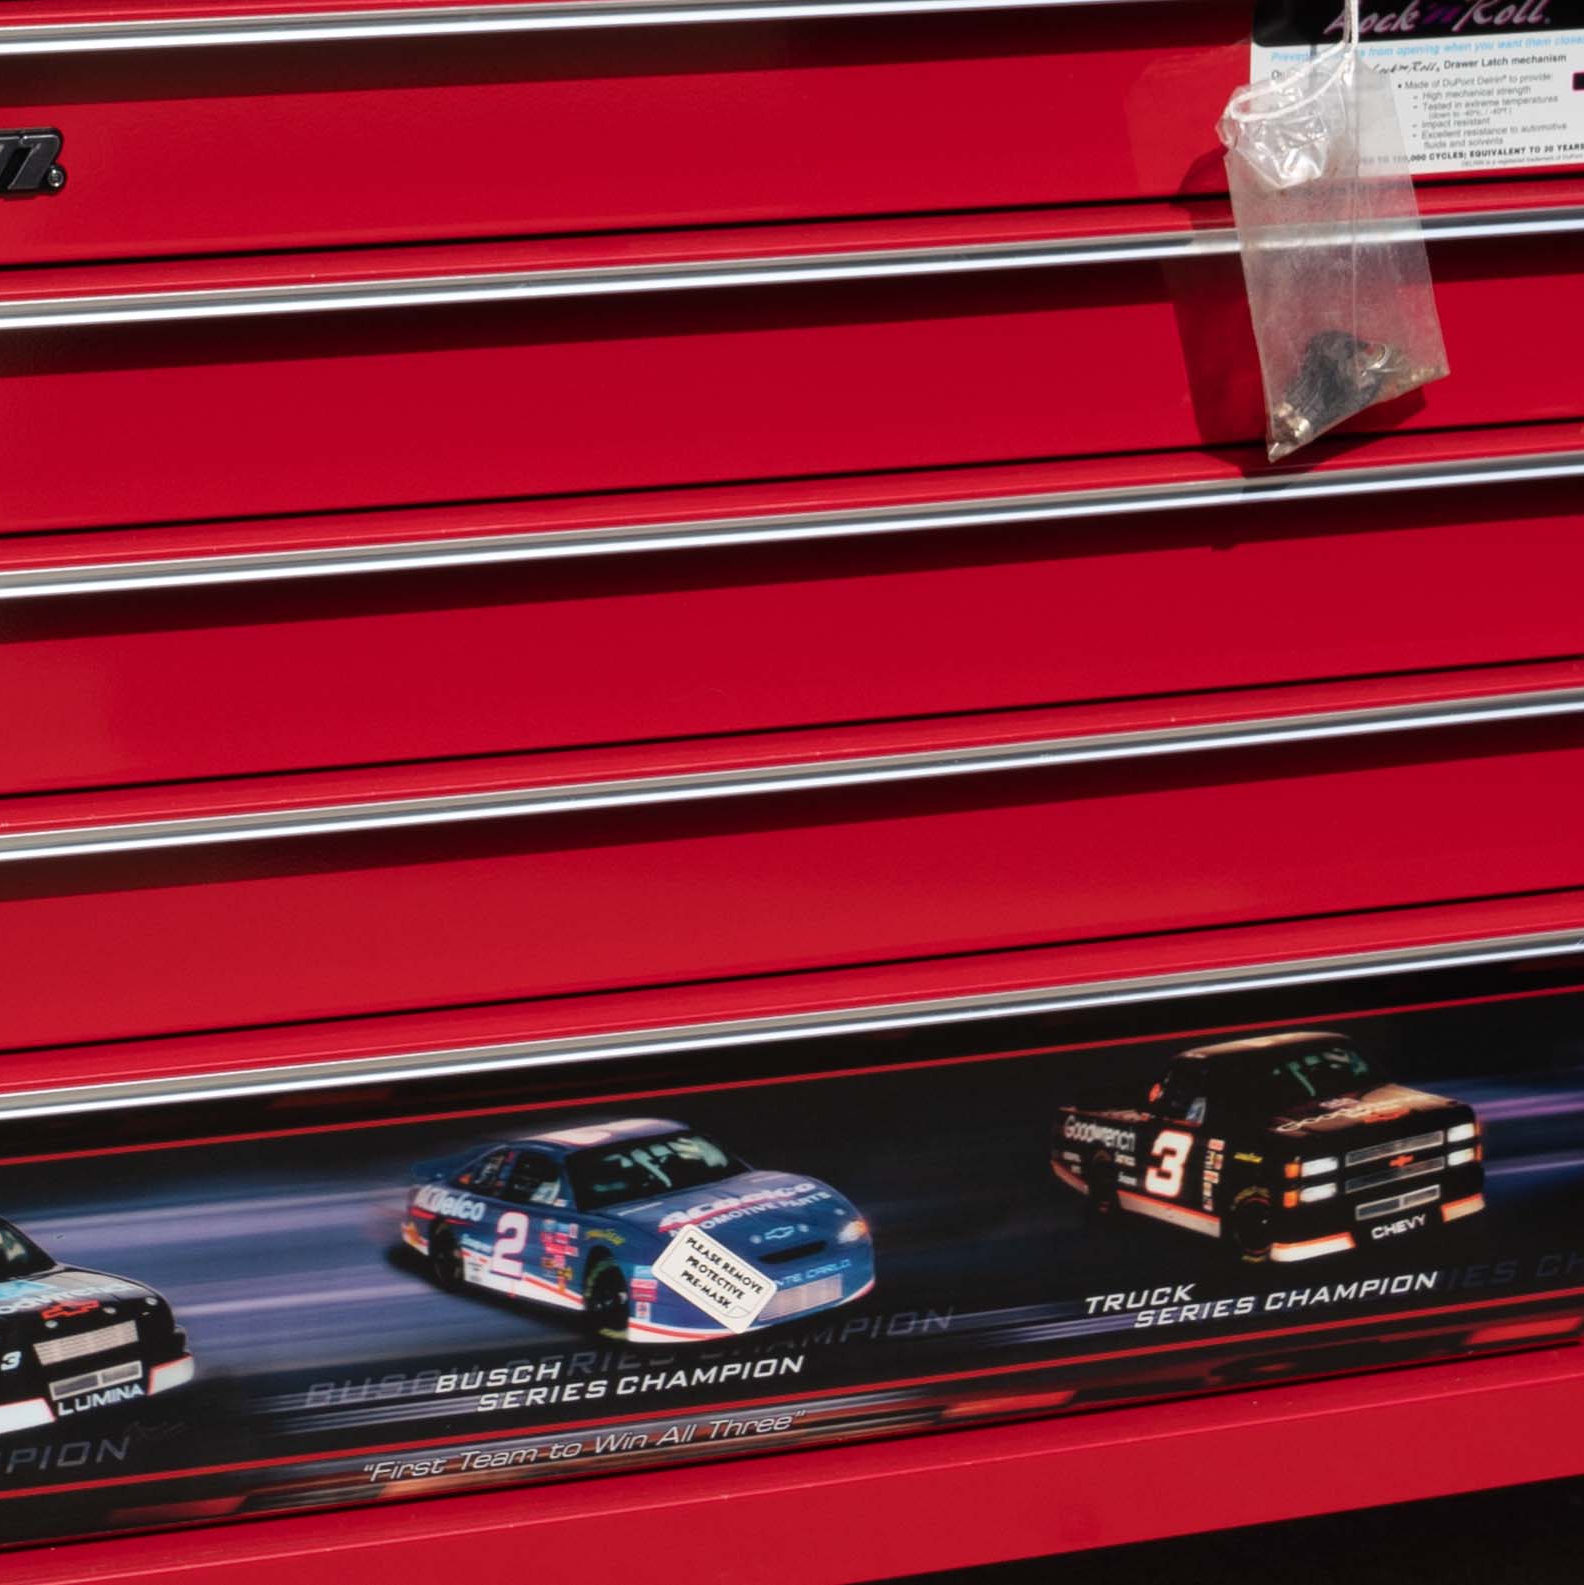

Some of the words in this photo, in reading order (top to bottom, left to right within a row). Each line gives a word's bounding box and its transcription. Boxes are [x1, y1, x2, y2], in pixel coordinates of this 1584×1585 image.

[1396, 43, 1440, 58] opening
[1443, 41, 1473, 52] when
[1474, 41, 1495, 55] you
[1496, 39, 1524, 49] want
[1524, 36, 1553, 47] them
[1443, 58, 1479, 70] Drawer
[1480, 56, 1509, 67] Latch
[1510, 53, 1567, 66] mechanism
[1404, 80, 1430, 91] Made
[1442, 76, 1476, 89] DuPont
[1421, 90, 1443, 103] High
[1444, 87, 1495, 101] mechanical
[1495, 85, 1532, 98] strength
[1421, 101, 1453, 112] Tested
[1464, 98, 1500, 110] extreme
[1501, 94, 1559, 108] temperatures
[1421, 118, 1452, 130] Impact
[1452, 116, 1491, 127] resistant
[1421, 128, 1461, 140] Excellent
[1462, 125, 1508, 138] resistance
[1520, 122, 1568, 133] automotive
[1448, 138, 1466, 149] and
[1468, 147, 1527, 159] EQUIVALENT
[1528, 145, 1542, 155] TO
[1144, 1128, 1195, 1199] 3
[1370, 1213, 1428, 1240] CHEVY
[491, 1210, 530, 1280] 2
[684, 1236, 723, 1267] PLEASE
[722, 1261, 765, 1296] REMOVE
[684, 1254, 746, 1301] PROTECTIVE
[680, 1269, 734, 1310] PRE-MASK
[1084, 1282, 1197, 1315] TRUCK
[1133, 1295, 1257, 1330] SERIES
[1263, 1271, 1440, 1312] CHAMPION
[0, 1351, 22, 1371] 3
[434, 1361, 563, 1394] BUSCH
[476, 1379, 610, 1414] SERIES
[616, 1354, 806, 1396] CHAMPION
[57, 1383, 145, 1417] LUMINA
[458, 1448, 539, 1472] Team
[548, 1441, 583, 1459] to
[593, 1427, 650, 1455] Win
[656, 1423, 699, 1447] All
